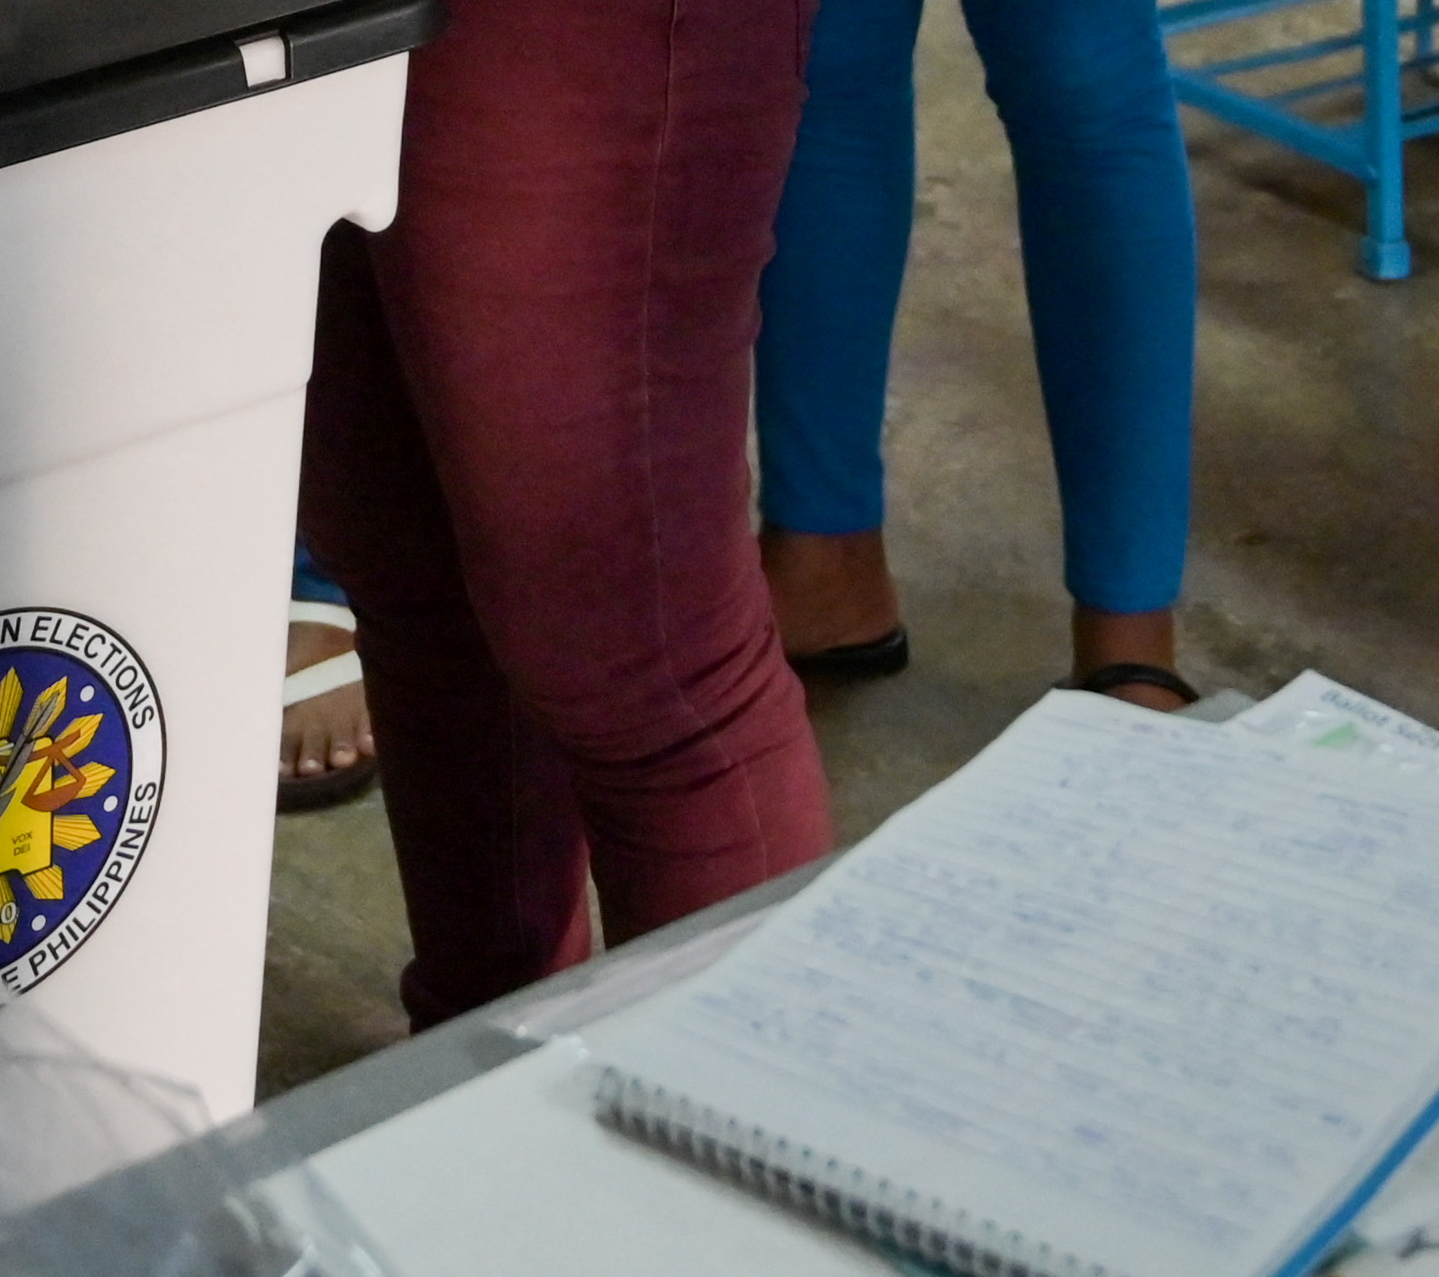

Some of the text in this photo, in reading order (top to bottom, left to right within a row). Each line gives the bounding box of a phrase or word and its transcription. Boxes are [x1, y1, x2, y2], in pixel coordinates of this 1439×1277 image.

[30, 616, 154, 731] ELECTIONS
[11, 830, 34, 846] VOX
[13, 843, 32, 857] DEI
[27, 781, 158, 978] PHILIPPINES
